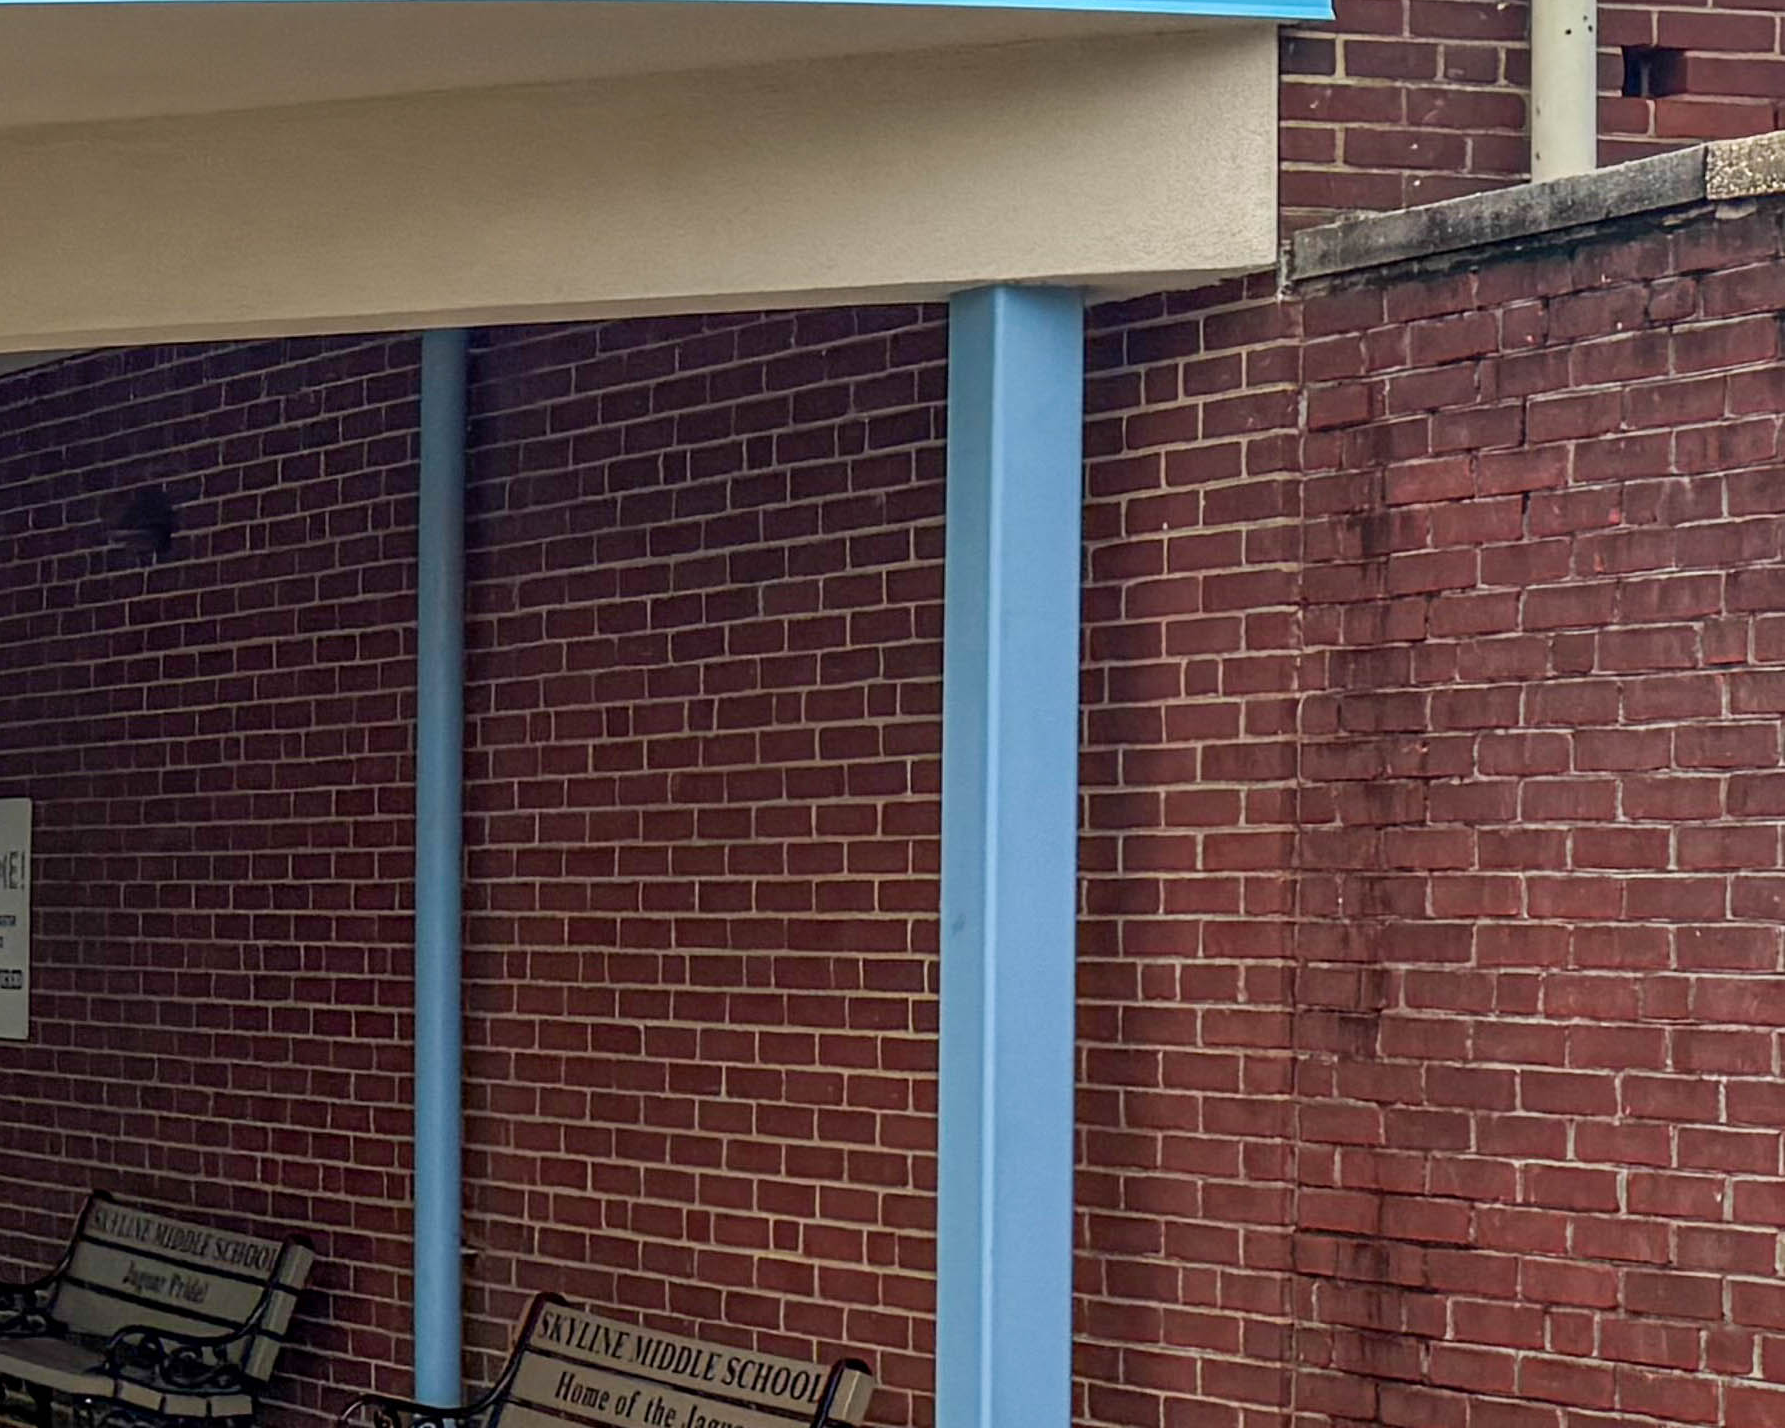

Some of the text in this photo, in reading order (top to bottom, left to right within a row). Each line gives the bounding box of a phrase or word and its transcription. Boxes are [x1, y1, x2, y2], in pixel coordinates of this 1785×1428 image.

[94, 1208, 153, 1243] SKYLINE
[154, 1220, 212, 1256] MIDDLE
[121, 1259, 167, 1294] Jaguar
[537, 1310, 824, 1405] SKYLINE MIDDLE SCHOOL
[554, 1370, 610, 1412] Home
[614, 1390, 642, 1418] of
